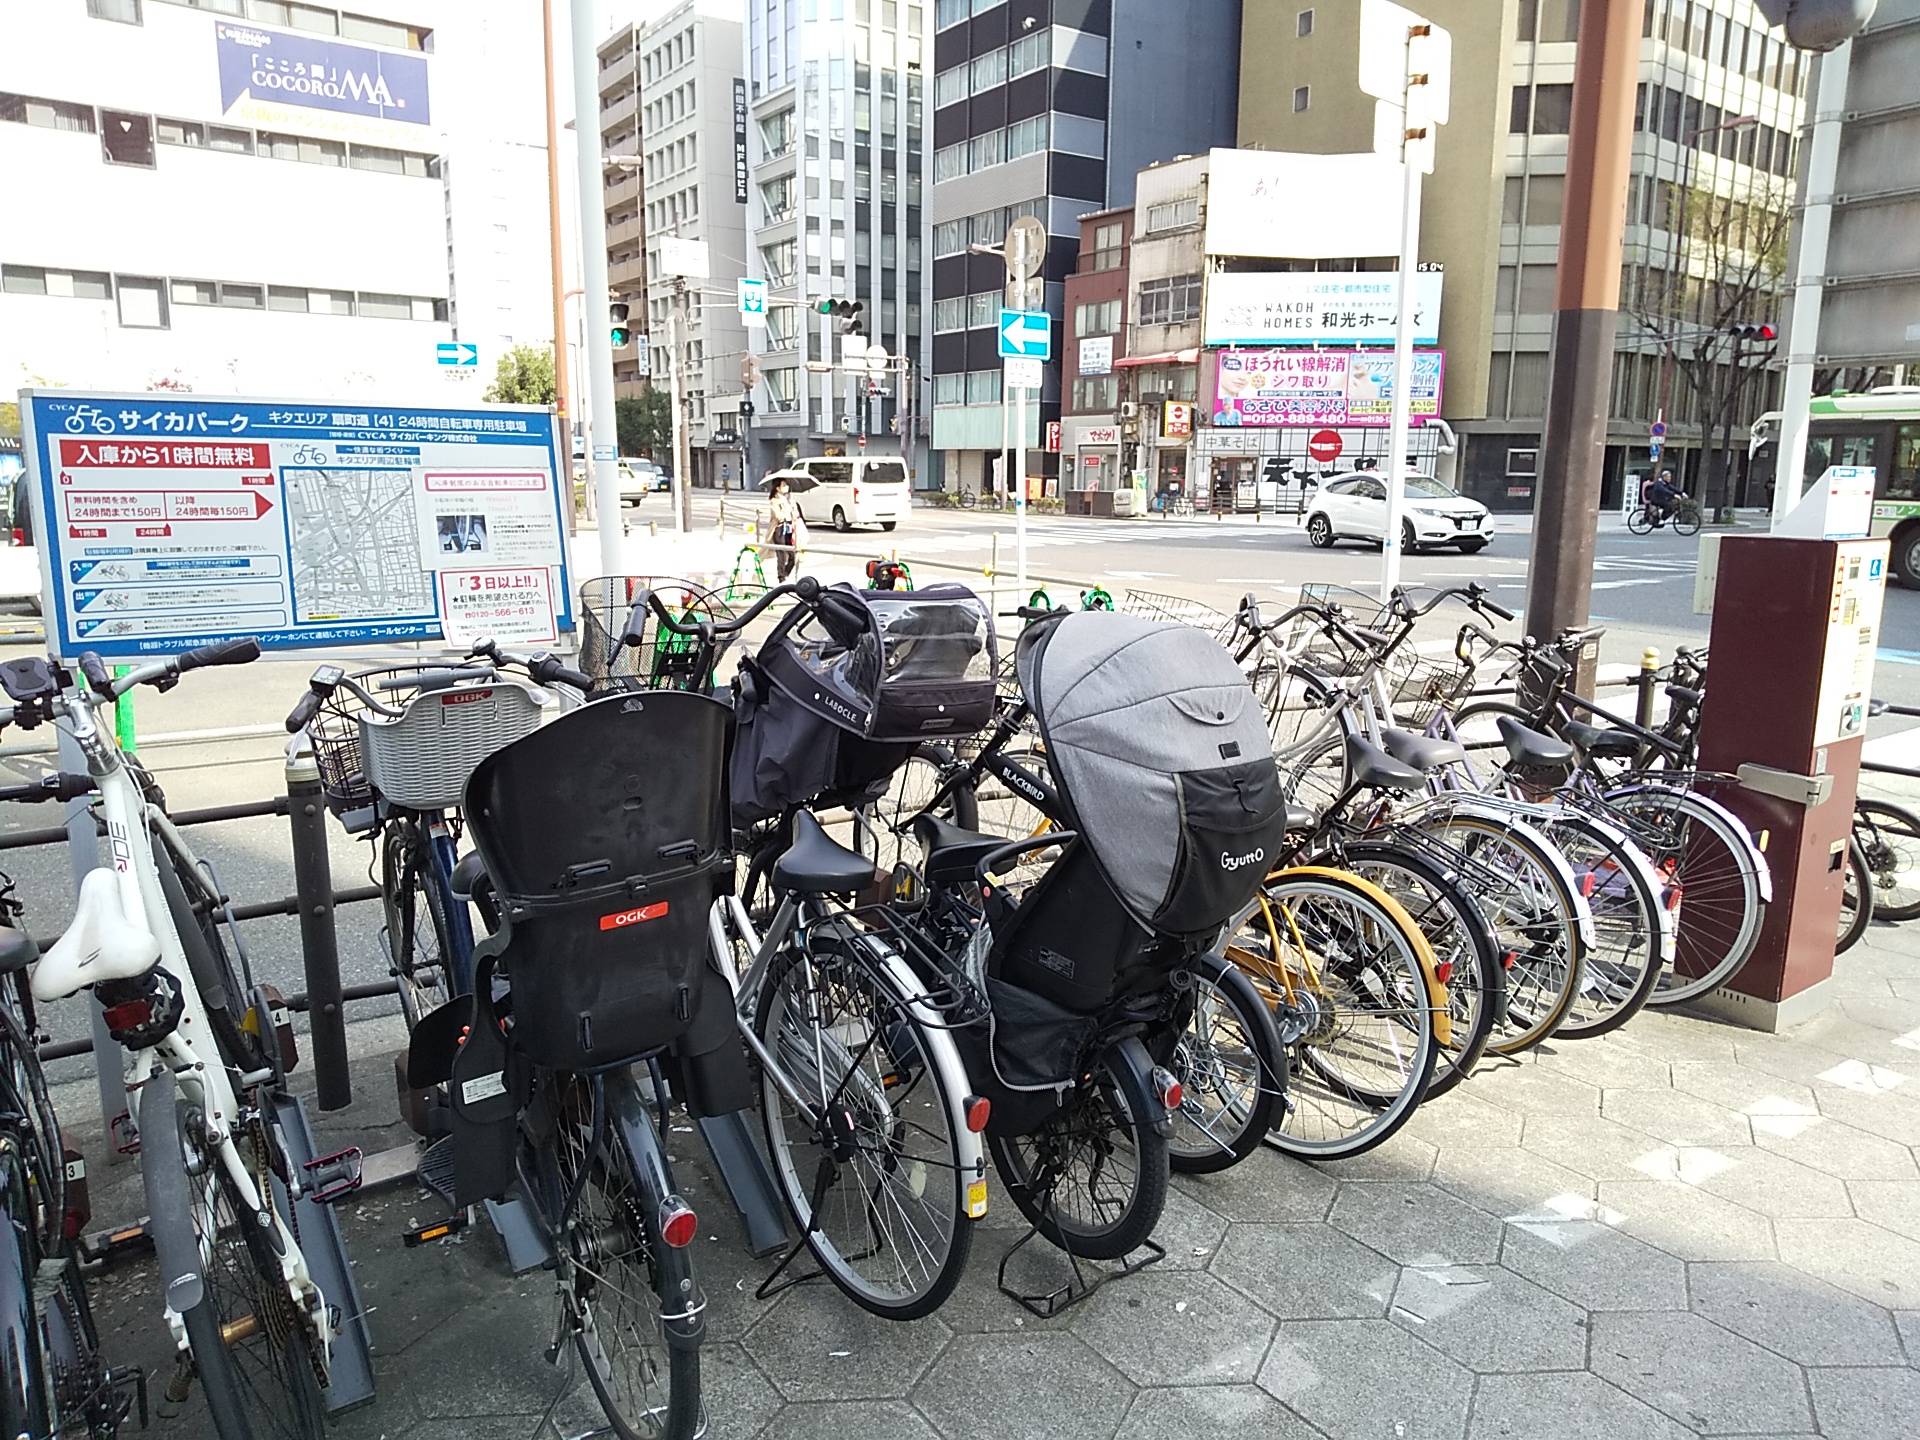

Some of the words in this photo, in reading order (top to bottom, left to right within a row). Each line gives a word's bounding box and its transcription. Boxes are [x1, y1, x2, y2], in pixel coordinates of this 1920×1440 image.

[1265, 302, 1314, 313] WAKOH
[1264, 317, 1313, 329] HOMES
[1245, 356, 1346, 373] ほうれい線解消
[1273, 375, 1329, 388] シワ取り
[49, 404, 75, 412] CYCA
[1244, 400, 1346, 413] あさひ美容外科
[118, 410, 250, 434] サイカパーク
[268, 411, 328, 425] キタエリア
[398, 415, 527, 432] 24時間自転車専用駐車場
[358, 432, 386, 440] CYCA
[1205, 435, 1259, 448] 中華そば
[76, 444, 255, 466] 入庫から1時間無料
[174, 495, 196, 505] 以降
[74, 507, 162, 518] 24時間まで150円
[175, 506, 249, 517] 24時間毎150円
[370, 625, 423, 636] コールセンター
[453, 691, 486, 702] OGK
[1002, 766, 1045, 801] BLACKBIRD
[615, 908, 648, 925] OGK
[275, 1011, 282, 1024] 4
[68, 1165, 75, 1178] 3
